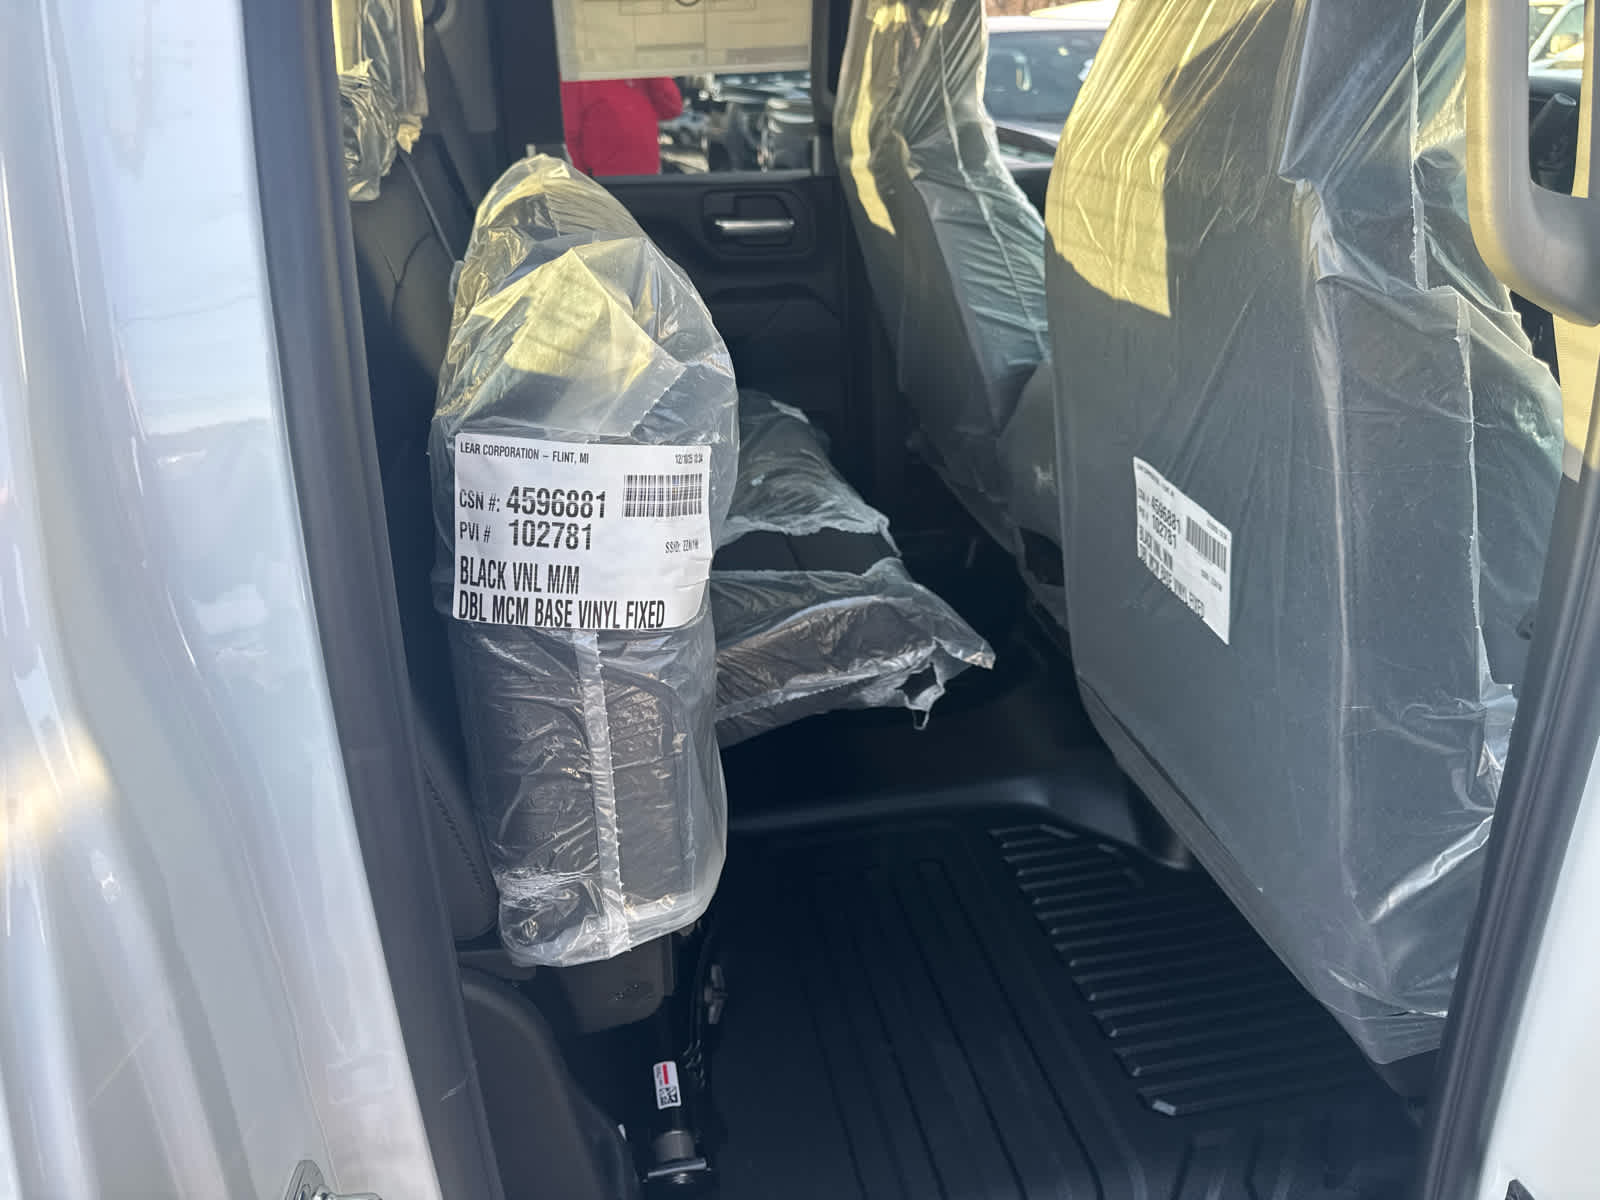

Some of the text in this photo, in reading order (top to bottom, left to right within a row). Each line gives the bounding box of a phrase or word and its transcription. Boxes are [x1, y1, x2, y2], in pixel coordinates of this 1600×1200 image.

[460, 442, 481, 455] LEAR
[483, 444, 540, 460] CORPORATION
[552, 451, 577, 464] FLINT,
[579, 453, 589, 464] MI
[460, 486, 606, 519] CSN #: 4596881
[460, 519, 592, 550] PVI # 102781
[460, 555, 580, 595] BLACK VNL M/M
[459, 590, 665, 629] DBL MCM BASE VINYL FIXED
